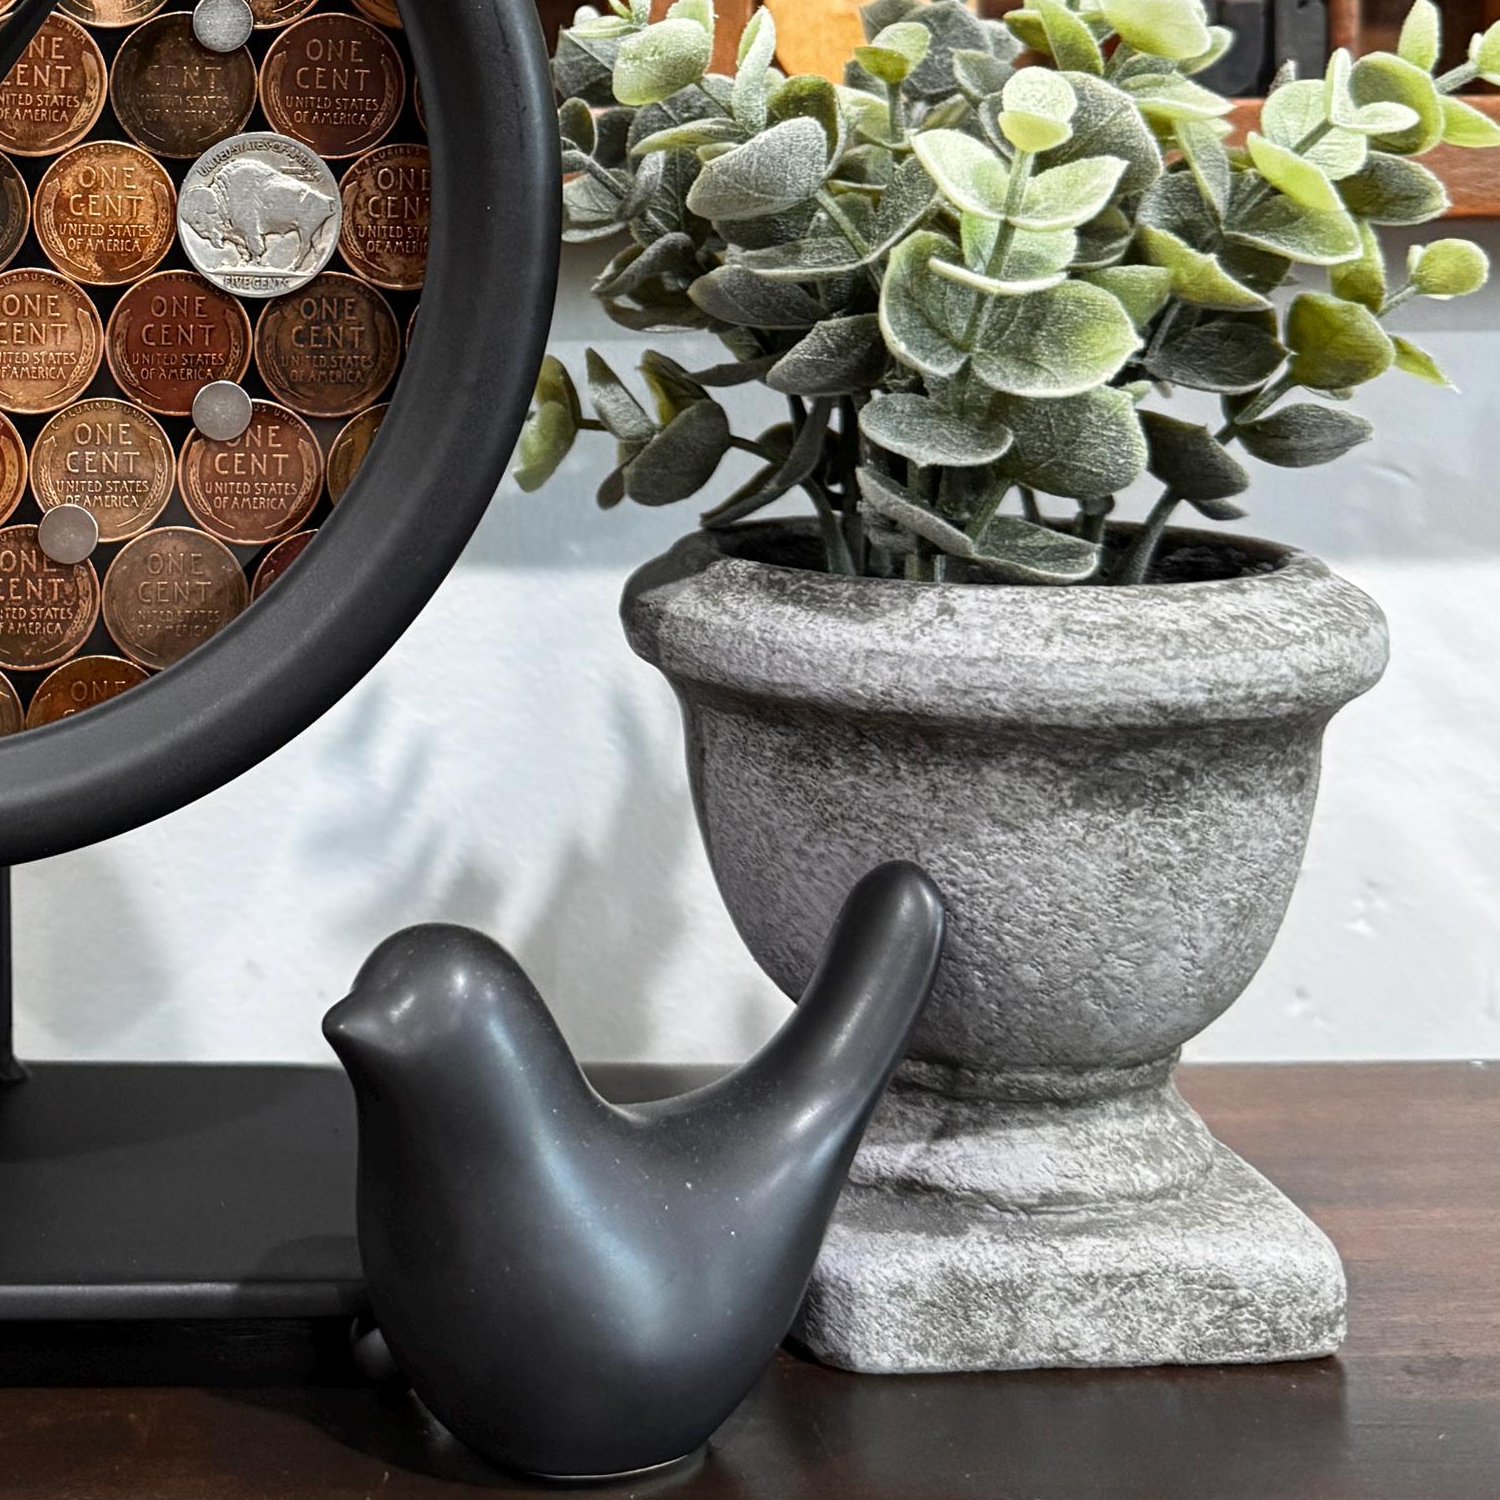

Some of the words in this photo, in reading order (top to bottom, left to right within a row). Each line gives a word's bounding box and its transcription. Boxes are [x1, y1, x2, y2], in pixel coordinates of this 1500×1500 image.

[304, 38, 363, 62] ONE
[295, 67, 371, 91] CENT
[197, 147, 233, 177] UNITED
[77, 165, 136, 189] ONE
[68, 194, 144, 218] CENT
[58, 223, 105, 236] UNITED
[108, 224, 152, 237] STATES
[224, 276, 251, 289] FIVE
[252, 277, 290, 289] CENTS
[2, 293, 61, 317] ONE
[150, 294, 209, 318] ONE
[299, 296, 358, 320] ONE
[141, 323, 217, 347] CENT
[290, 325, 366, 349] CENT
[33, 352, 77, 365] STATES
[74, 421, 133, 445] ONE
[65, 450, 141, 474] CENT
[214, 453, 290, 477] CENT
[55, 479, 102, 492] UNITED
[105, 480, 149, 493] STATES
